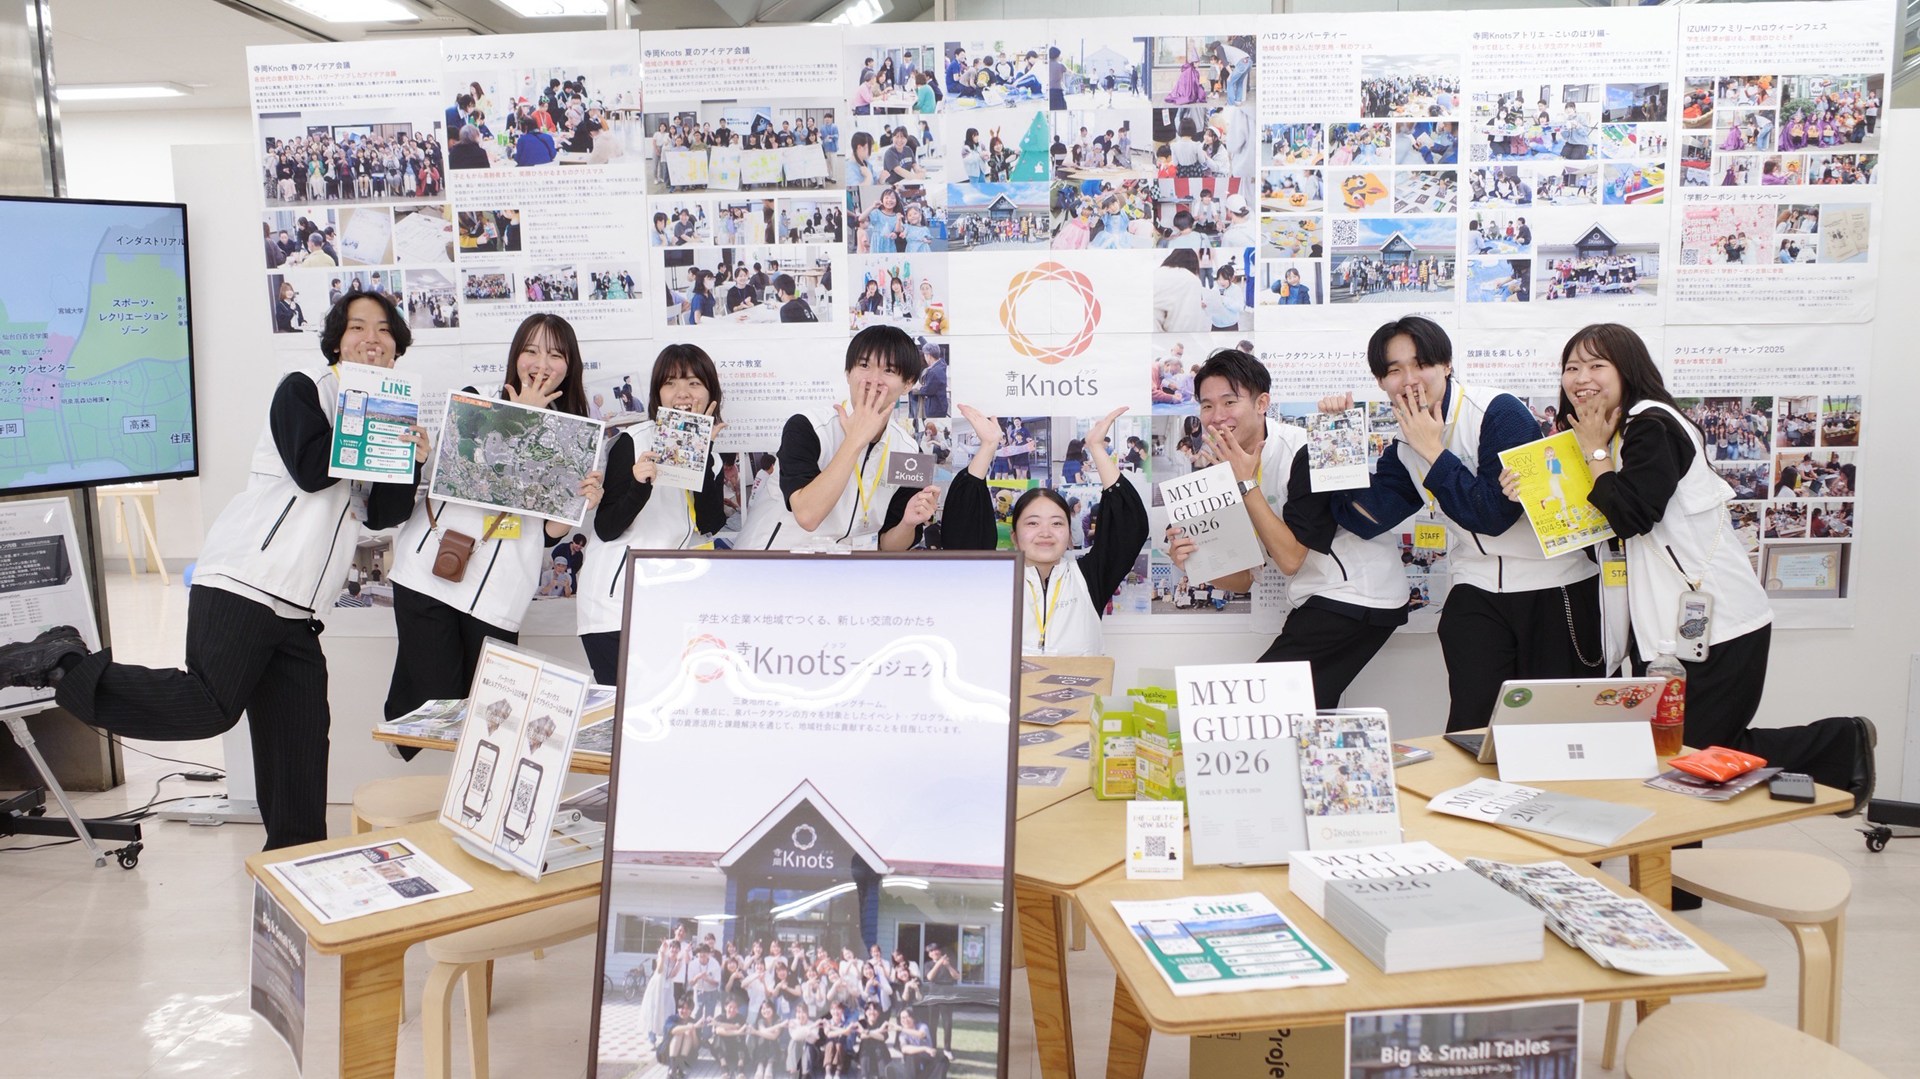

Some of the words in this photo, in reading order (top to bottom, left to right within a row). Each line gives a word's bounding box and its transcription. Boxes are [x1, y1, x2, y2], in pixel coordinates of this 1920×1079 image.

[446, 50, 515, 63] クリスマスフェスタ
[644, 48, 682, 58] 寺岡Knots
[685, 46, 750, 57] 夏のアイデア会議
[253, 63, 288, 73] 寺岡Knots
[291, 61, 350, 72] 春のアイデア会議
[99, 312, 169, 322] レクリエーション
[120, 325, 149, 335] ゾーン
[1675, 345, 1785, 355] クリエイティブキャンプ2025
[8, 363, 76, 375] タウンセンター
[381, 381, 412, 397] LINE
[1021, 374, 1098, 397] Knots
[129, 419, 151, 430] 高森
[170, 433, 191, 444] 住居
[1519, 466, 1539, 479] ASIC
[1167, 478, 1209, 503] MYU
[1174, 491, 1236, 522] GUIDE
[1180, 516, 1220, 540] 2026
[1420, 532, 1440, 540] STAFF
[754, 646, 847, 677] Knots
[1189, 678, 1267, 706] MYU
[1192, 713, 1305, 743] GUIDE
[1196, 749, 1270, 776] 2026
[1445, 788, 1494, 809] MYU
[1480, 788, 1542, 815] GUIDE
[782, 850, 834, 869] Knots
[1312, 851, 1396, 867] MYU
[1331, 860, 1456, 879] GUIDE
[1347, 878, 1431, 894] 2026
[1193, 903, 1253, 917] LINE
[1380, 1046, 1412, 1068] Big
[1418, 1045, 1433, 1062] &
[1439, 1041, 1490, 1062] Small
[1494, 1038, 1551, 1059] Tables
